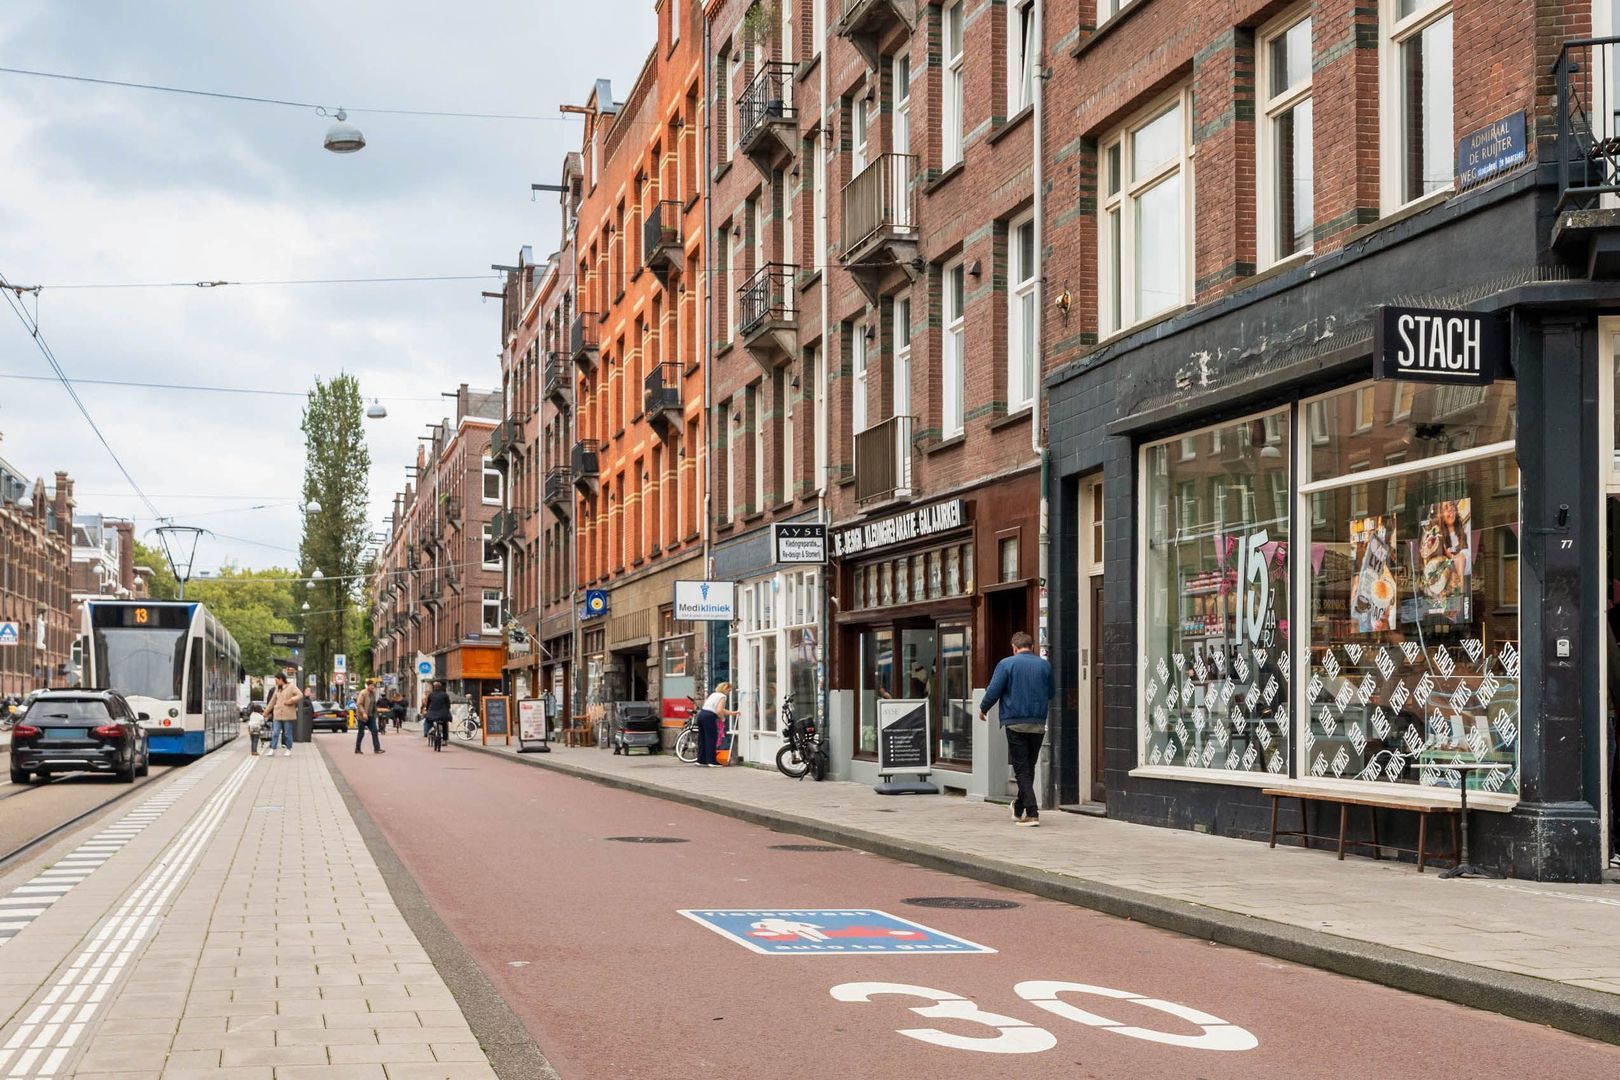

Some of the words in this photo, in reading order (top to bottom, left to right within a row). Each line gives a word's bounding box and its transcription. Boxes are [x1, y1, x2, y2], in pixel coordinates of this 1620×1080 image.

[1471, 122, 1510, 149] ADMIRAAL
[1469, 151, 1479, 166] DE
[1460, 167, 1477, 184] WEG
[1398, 314, 1480, 370] STACH
[780, 527, 822, 537] AYSE
[1560, 539, 1573, 549] 77
[1236, 528, 1269, 646] 15
[135, 608, 148, 624] 13
[679, 603, 731, 612] Medikliniek
[1433, 643, 1456, 680] STACH
[1492, 708, 1518, 747] STACH
[829, 980, 1259, 1055] 30
